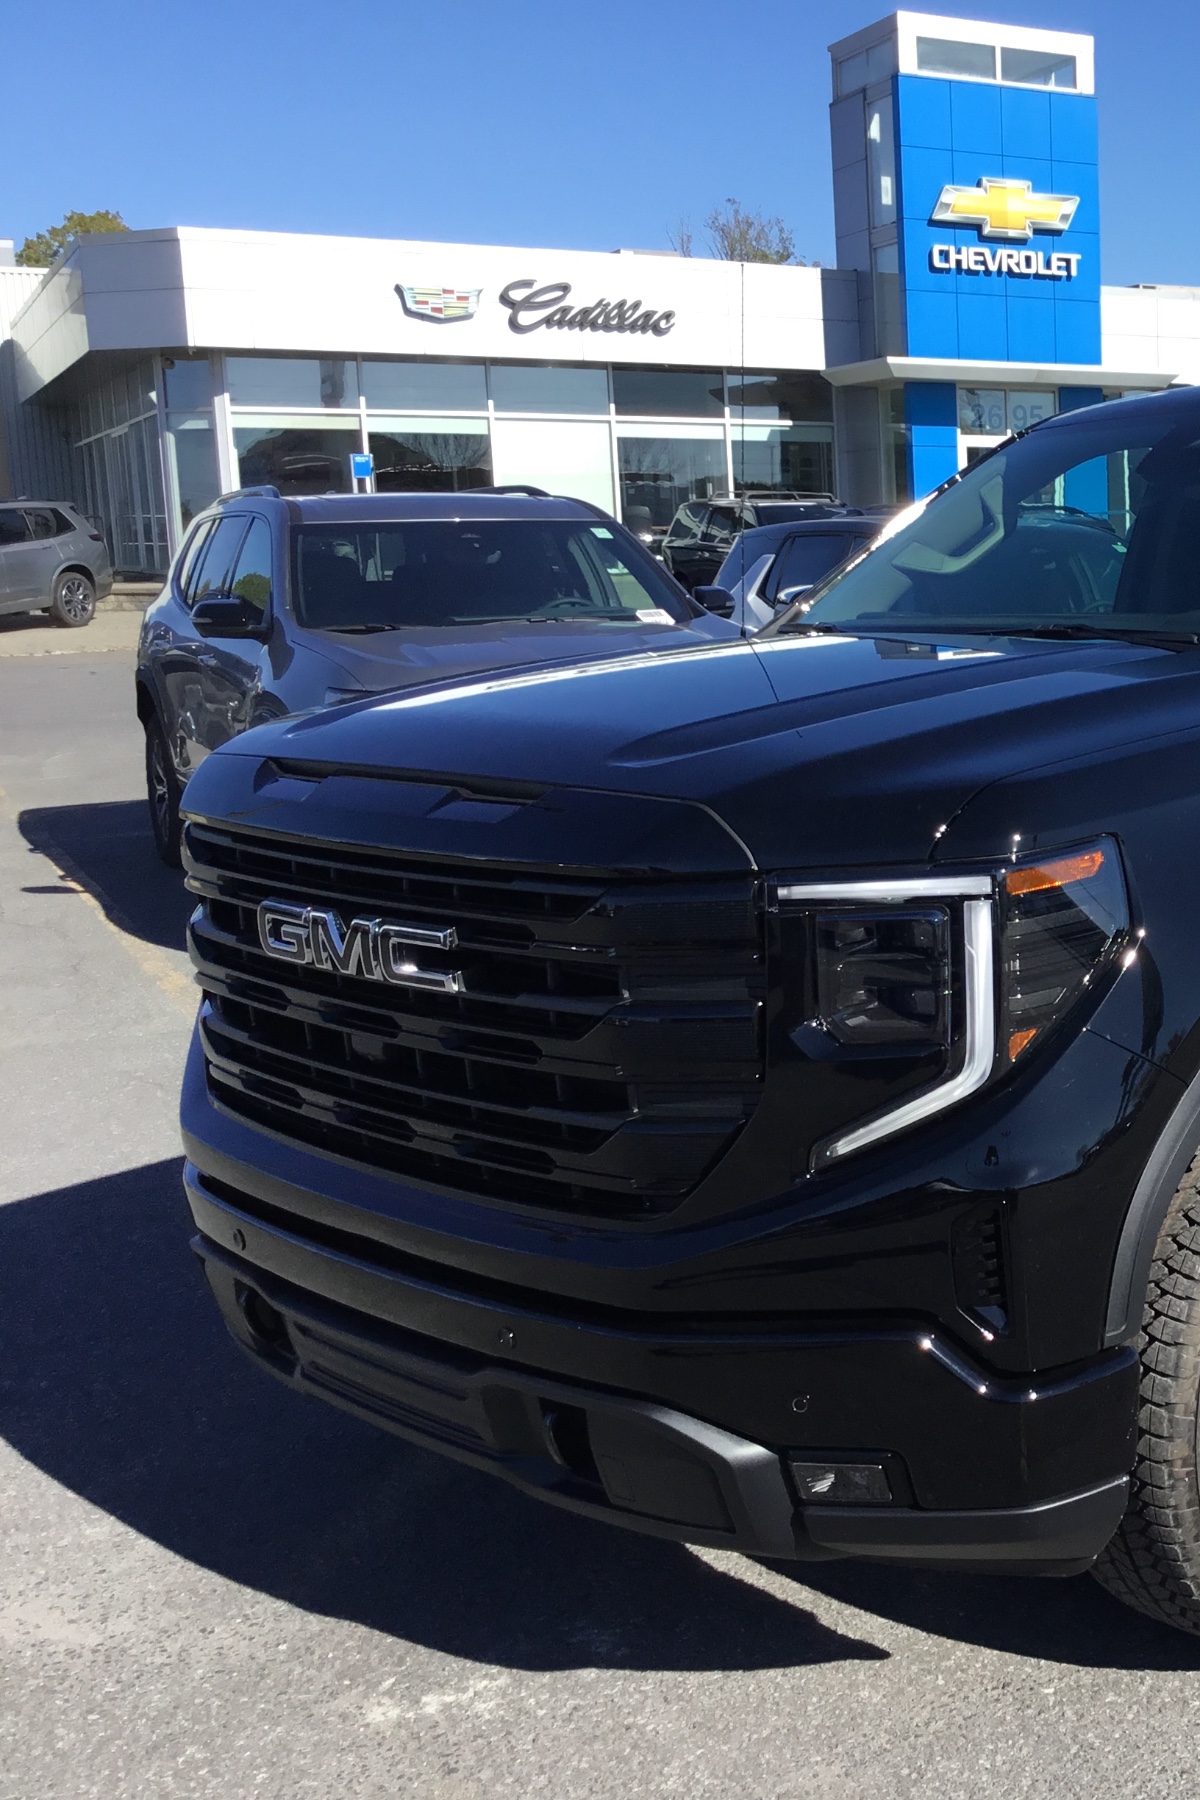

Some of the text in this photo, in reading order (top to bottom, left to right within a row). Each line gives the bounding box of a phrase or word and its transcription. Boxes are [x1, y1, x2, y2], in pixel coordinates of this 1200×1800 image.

[931, 243, 1082, 277] CHEVROLET
[498, 279, 676, 336] Cadillac
[256, 896, 467, 993] GMC
